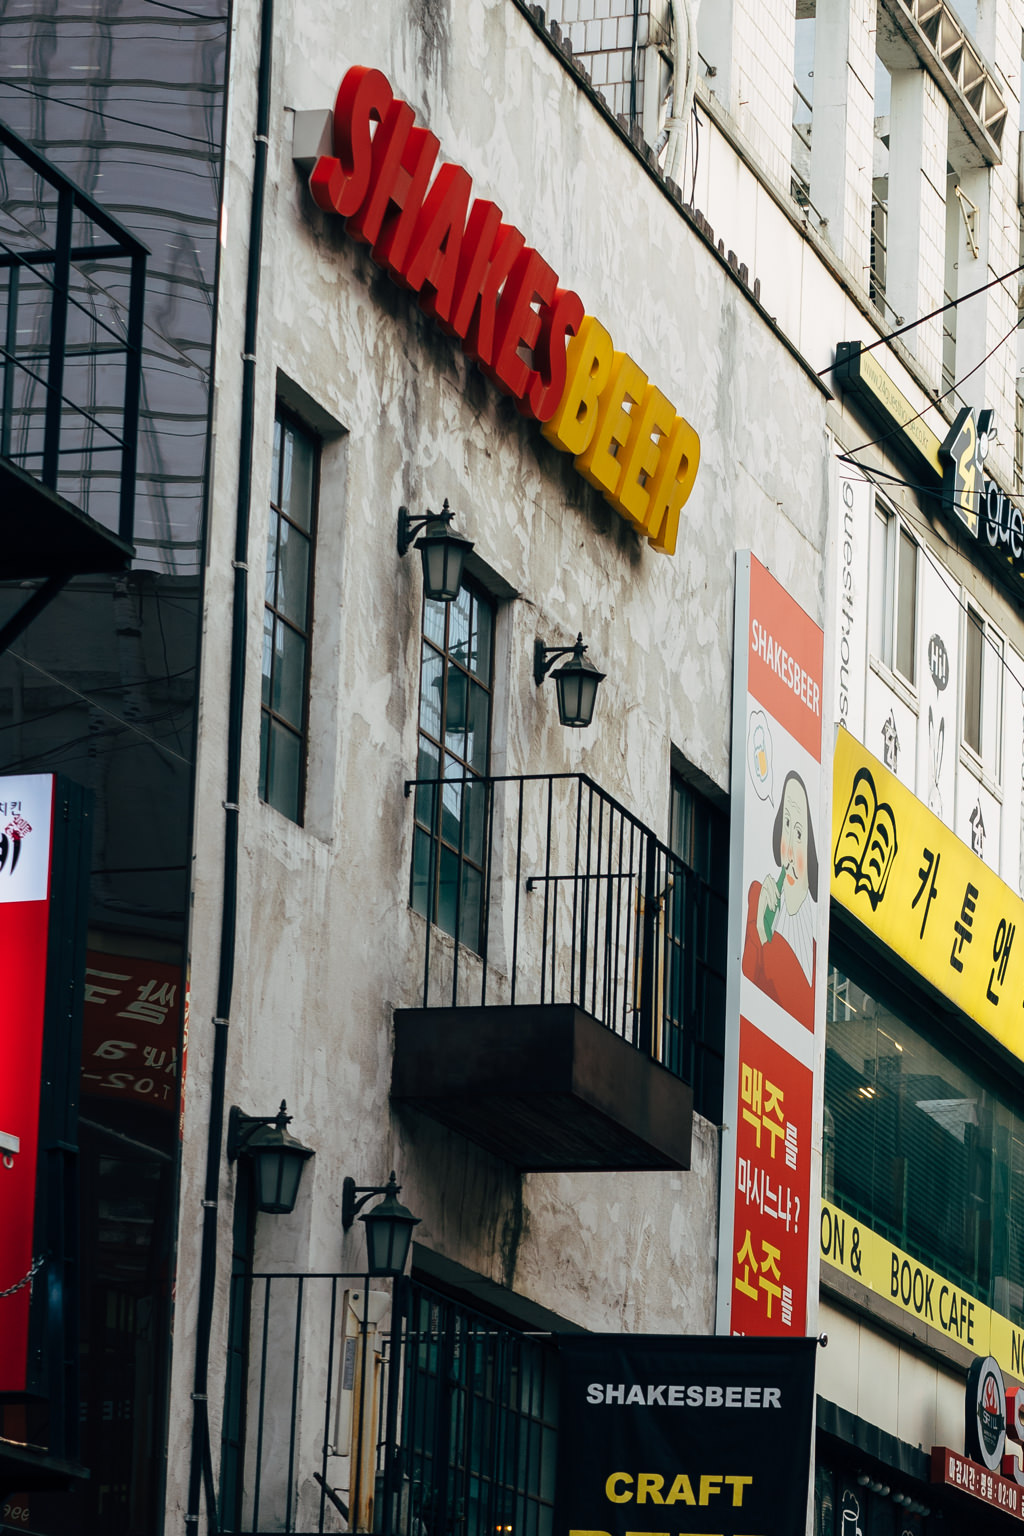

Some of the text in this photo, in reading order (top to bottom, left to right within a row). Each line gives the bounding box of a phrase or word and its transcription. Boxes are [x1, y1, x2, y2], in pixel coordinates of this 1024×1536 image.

[310, 64, 700, 556] SHAKESBEER
[751, 618, 820, 717] SHAKESBEER
[930, 643, 948, 684] Hi!
[741, 1061, 798, 1171] 맥주를
[738, 1156, 801, 1234] 마시느냐?
[735, 1228, 793, 1327] 소주를
[850, 1226, 862, 1277] &
[890, 1251, 934, 1321] BOOK
[938, 1285, 975, 1346] CAFE
[586, 1383, 782, 1408] SHAKESBEER
[605, 1472, 753, 1507] CRAFT
